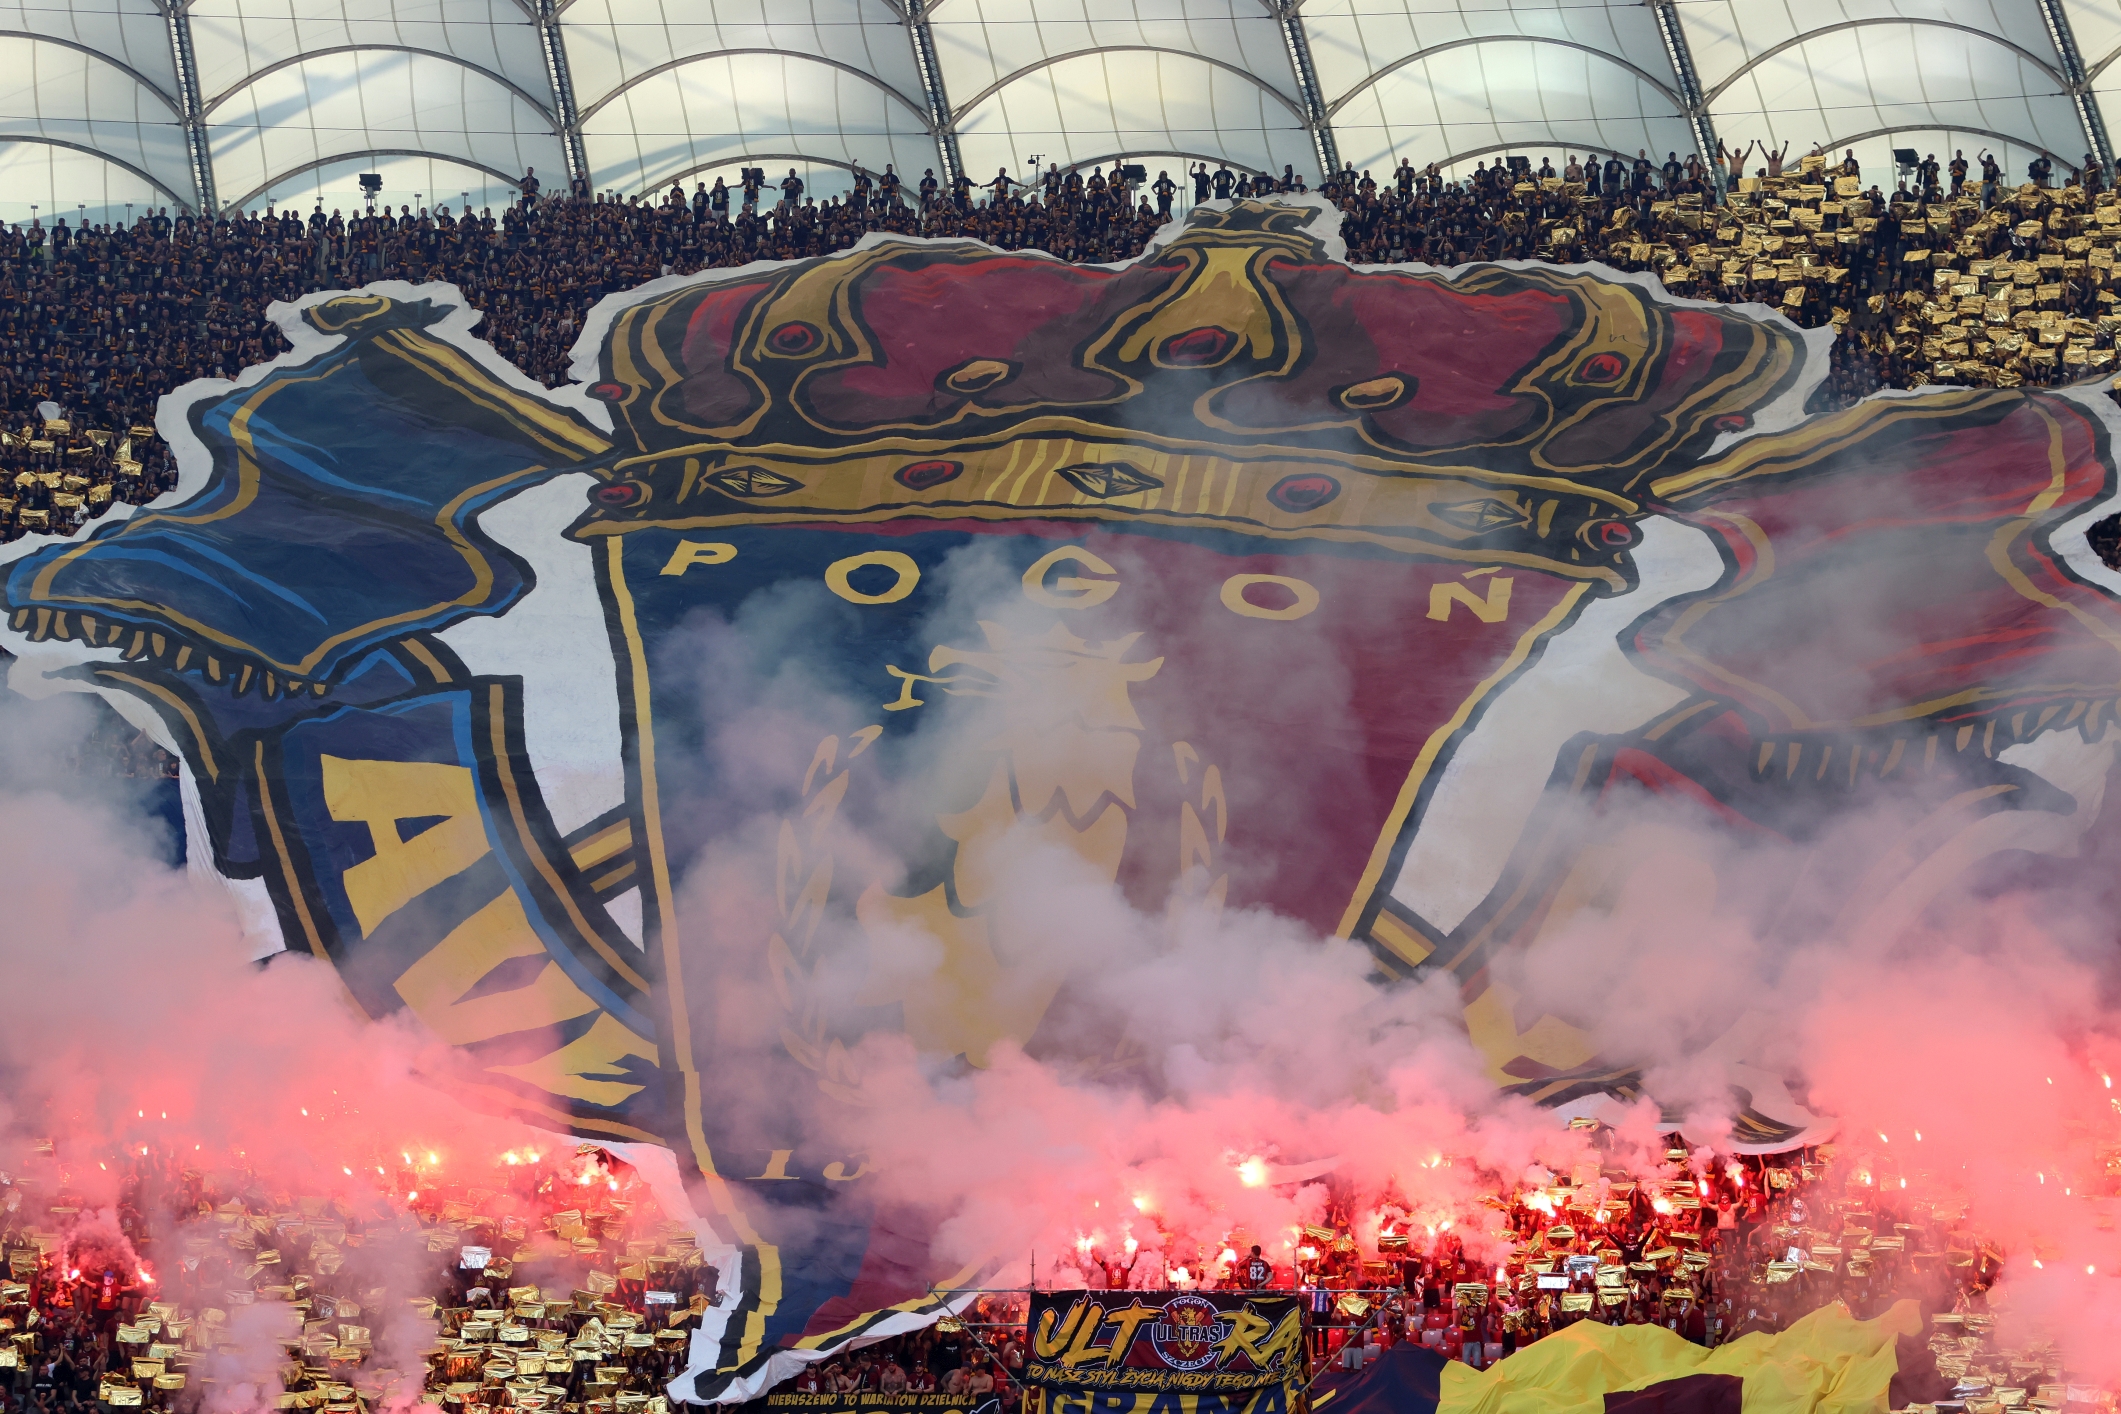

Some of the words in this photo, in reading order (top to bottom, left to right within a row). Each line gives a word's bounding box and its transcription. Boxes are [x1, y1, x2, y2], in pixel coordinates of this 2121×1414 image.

[658, 539, 1514, 623] POGOŃ
[1249, 1266, 1265, 1281] 82
[1156, 1322, 1221, 1343] ULTRAS
[1161, 1350, 1218, 1368] SZCZECIN
[1026, 1362, 1044, 1379] TO
[1043, 1364, 1083, 1384] NASZ
[1083, 1367, 1120, 1388] STYL
[1166, 1369, 1215, 1390] NIGDY
[1214, 1372, 1255, 1390] TEGO
[1253, 1370, 1281, 1388] NIE
[767, 1393, 838, 1406] NIEBUSZEWO
[843, 1393, 858, 1406] TO
[920, 1393, 978, 1406] DZIELNICA
